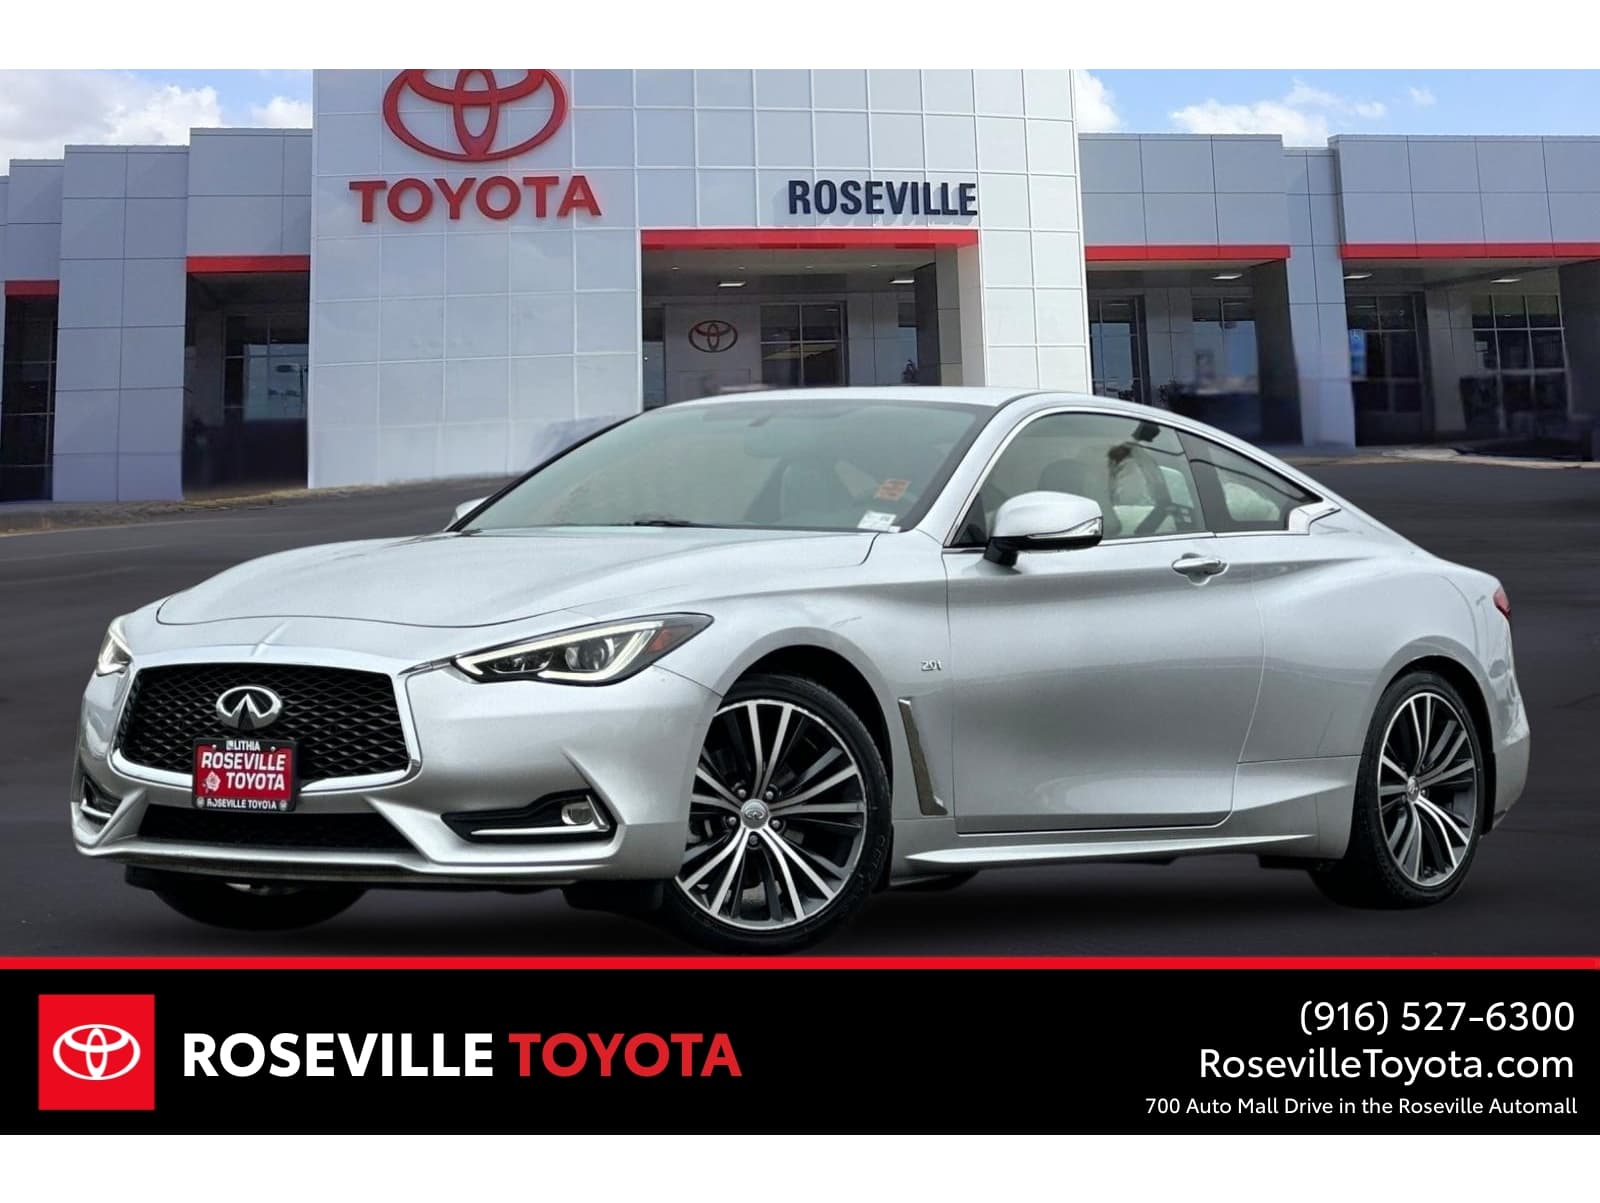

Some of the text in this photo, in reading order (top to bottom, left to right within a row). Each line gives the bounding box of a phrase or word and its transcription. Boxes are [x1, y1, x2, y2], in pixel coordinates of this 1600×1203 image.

[349, 175, 602, 223] TOYOTA
[787, 179, 979, 218] ROSEVILLE
[234, 740, 261, 751] LITHIA
[201, 752, 287, 771] ROSEVILLE
[226, 772, 285, 791] TOYOTA
[206, 798, 277, 810] ROSEVILLE TOYOTA
